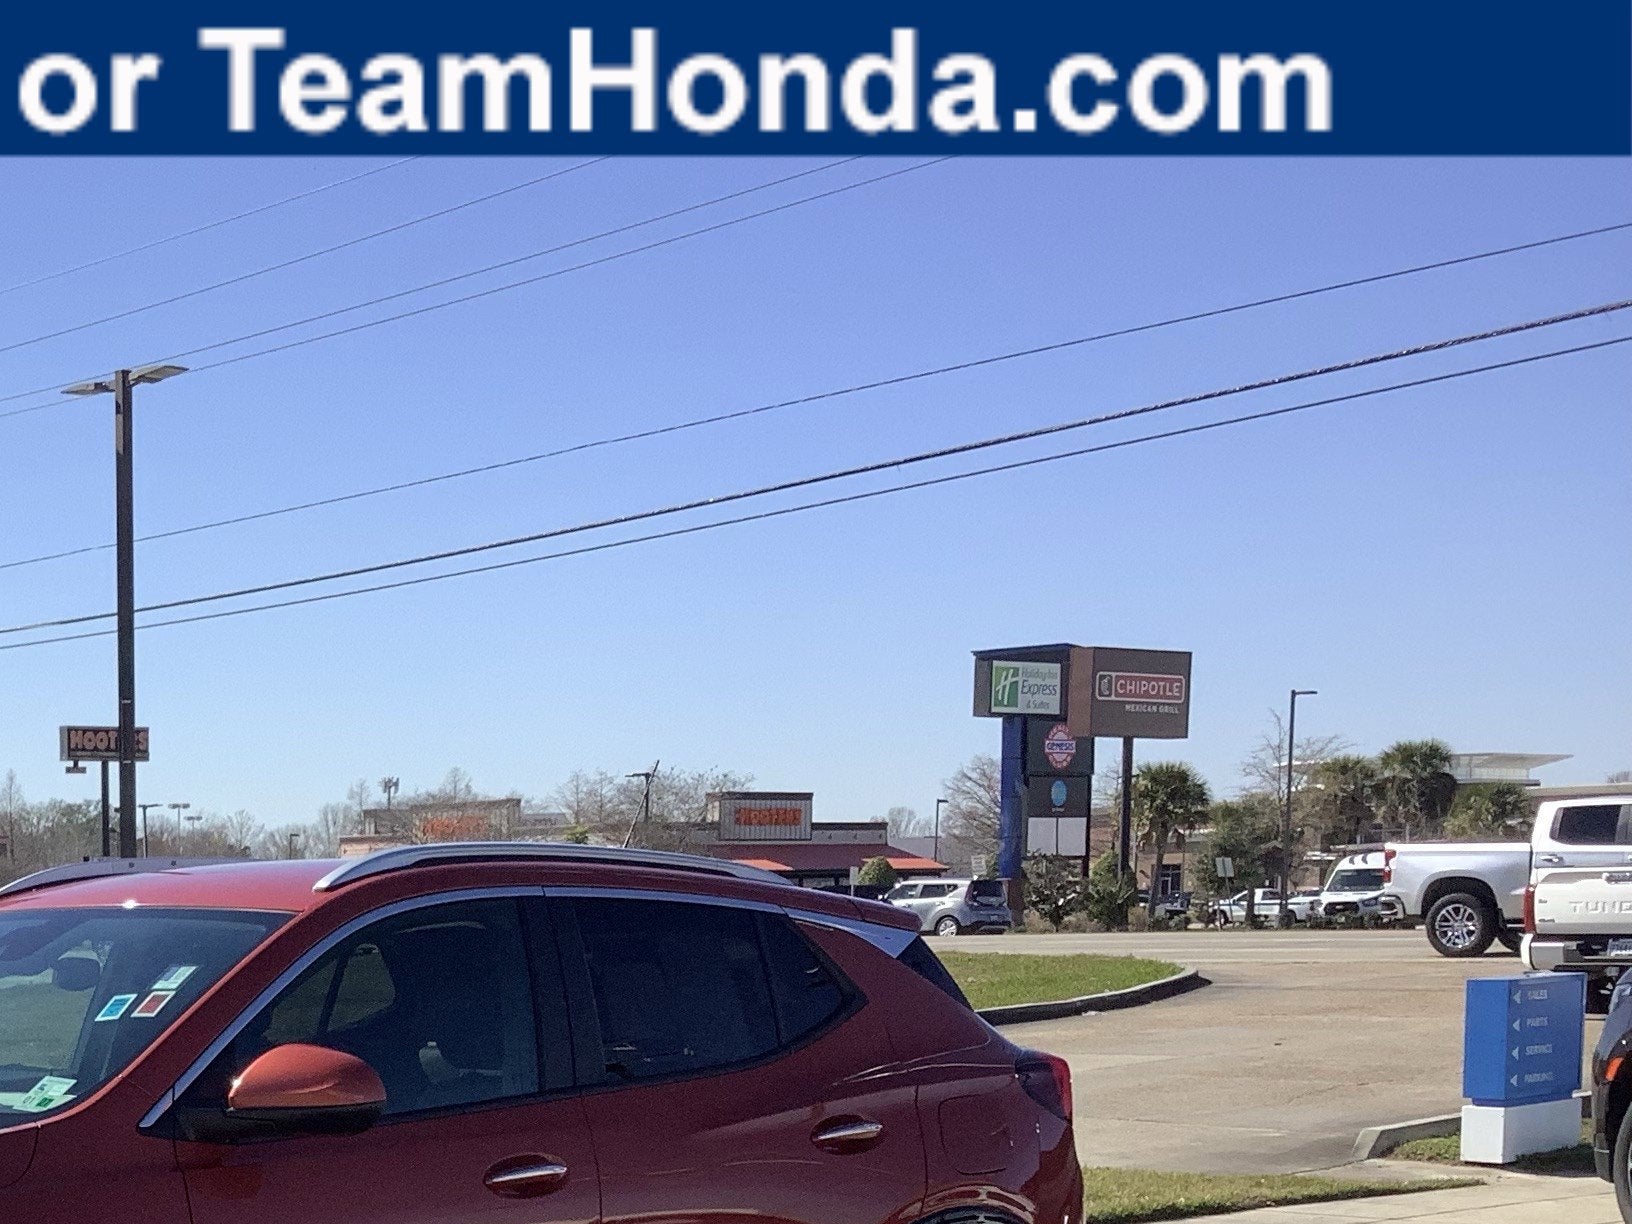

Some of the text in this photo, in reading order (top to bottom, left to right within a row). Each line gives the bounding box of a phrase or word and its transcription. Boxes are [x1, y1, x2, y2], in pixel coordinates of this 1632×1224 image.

[1021, 679, 1058, 698] Express
[1116, 679, 1182, 697] CHIPOTLE
[1125, 704, 1180, 714] MEXICAN GRILL
[1526, 1016, 1549, 1027] PARTS
[1525, 1043, 1553, 1056] SERVICE
